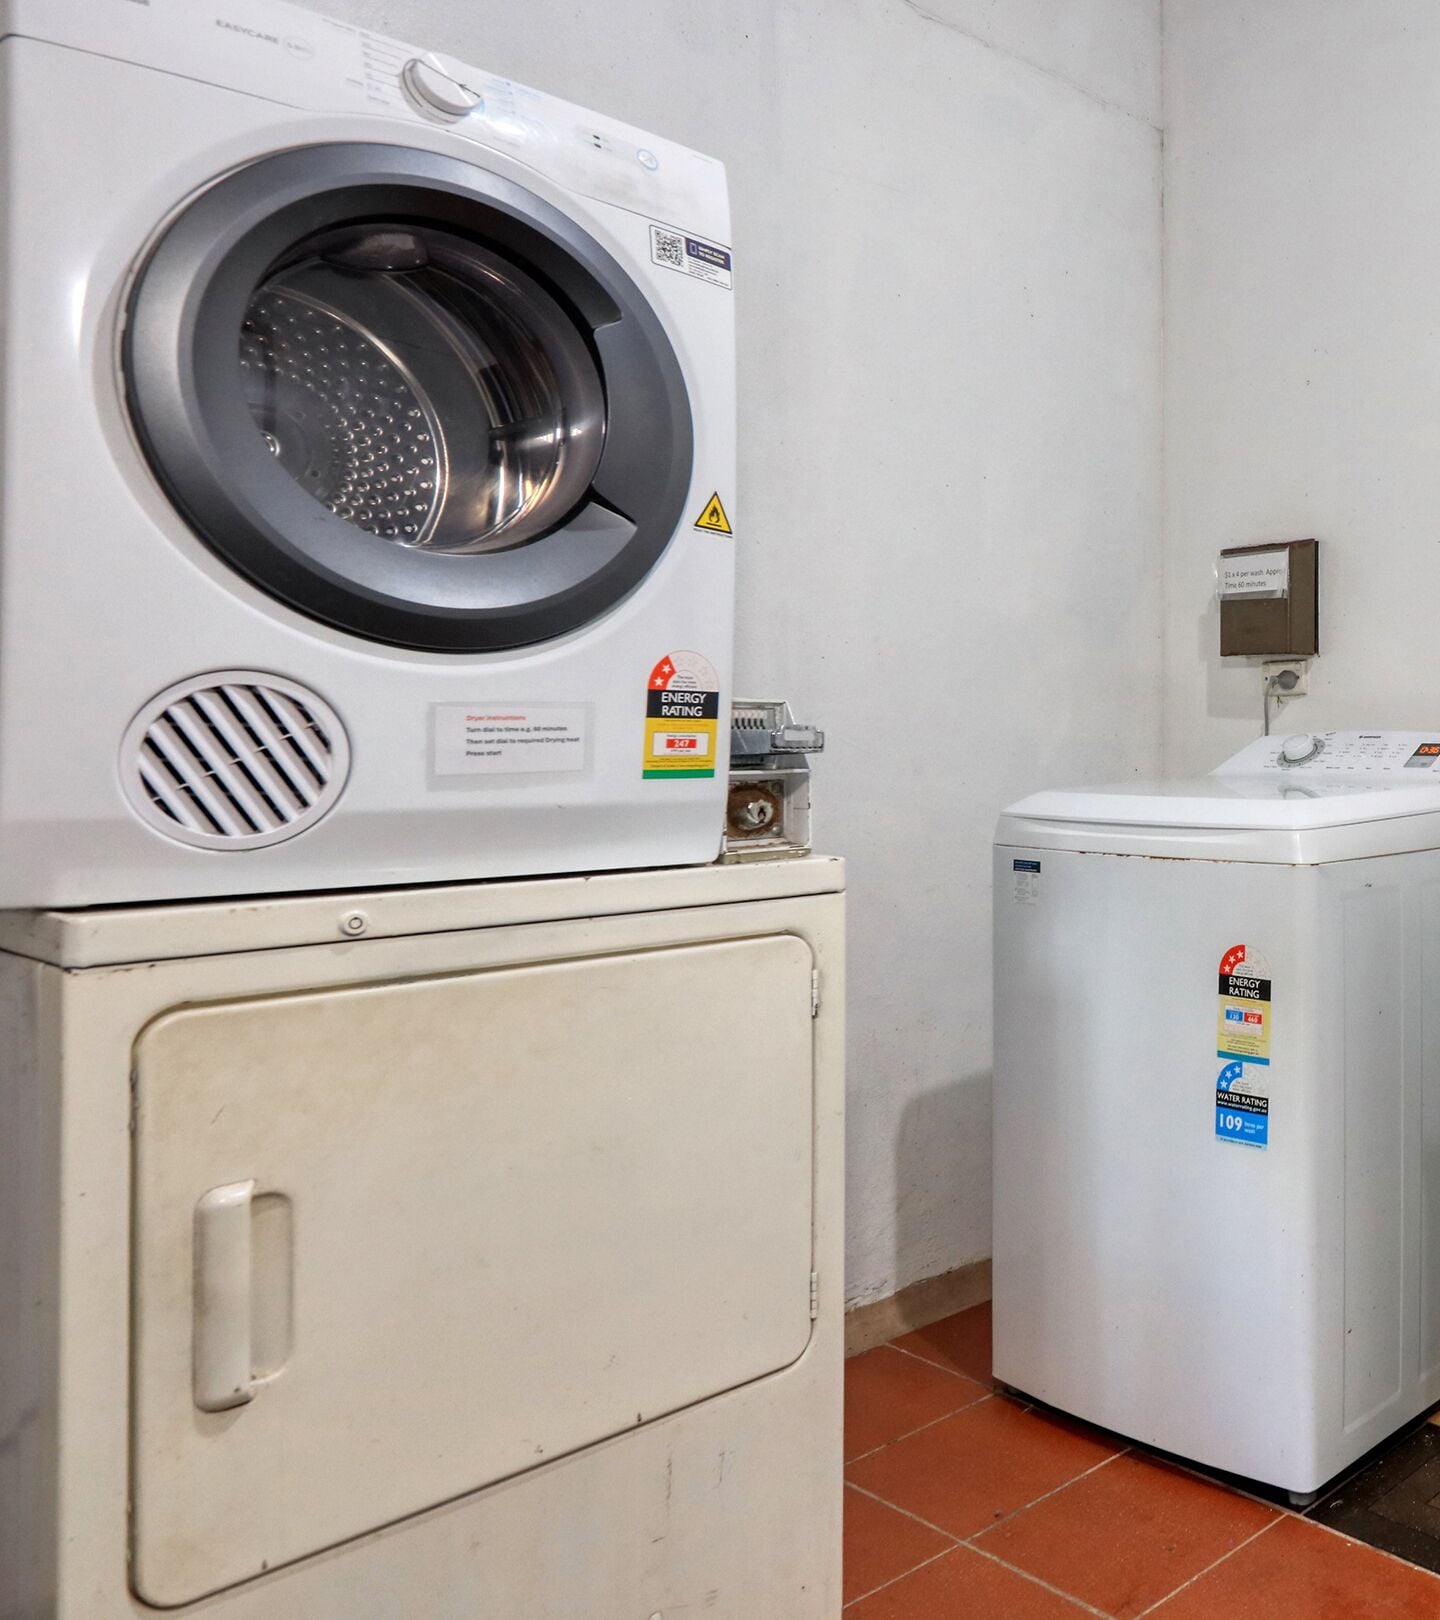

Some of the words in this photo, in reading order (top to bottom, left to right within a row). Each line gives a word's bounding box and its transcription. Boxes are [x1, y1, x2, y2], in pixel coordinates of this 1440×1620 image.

[215, 19, 279, 45] EASYCARE
[661, 692, 707, 704] ENERGY
[661, 705, 703, 717] RATING
[673, 739, 690, 748] 247
[1228, 977, 1261, 989] ENERGY
[1228, 987, 1260, 999] RATING
[1217, 1091, 1241, 1103] WATER
[1241, 1097, 1268, 1108] RATING
[1220, 1113, 1243, 1132] 109
